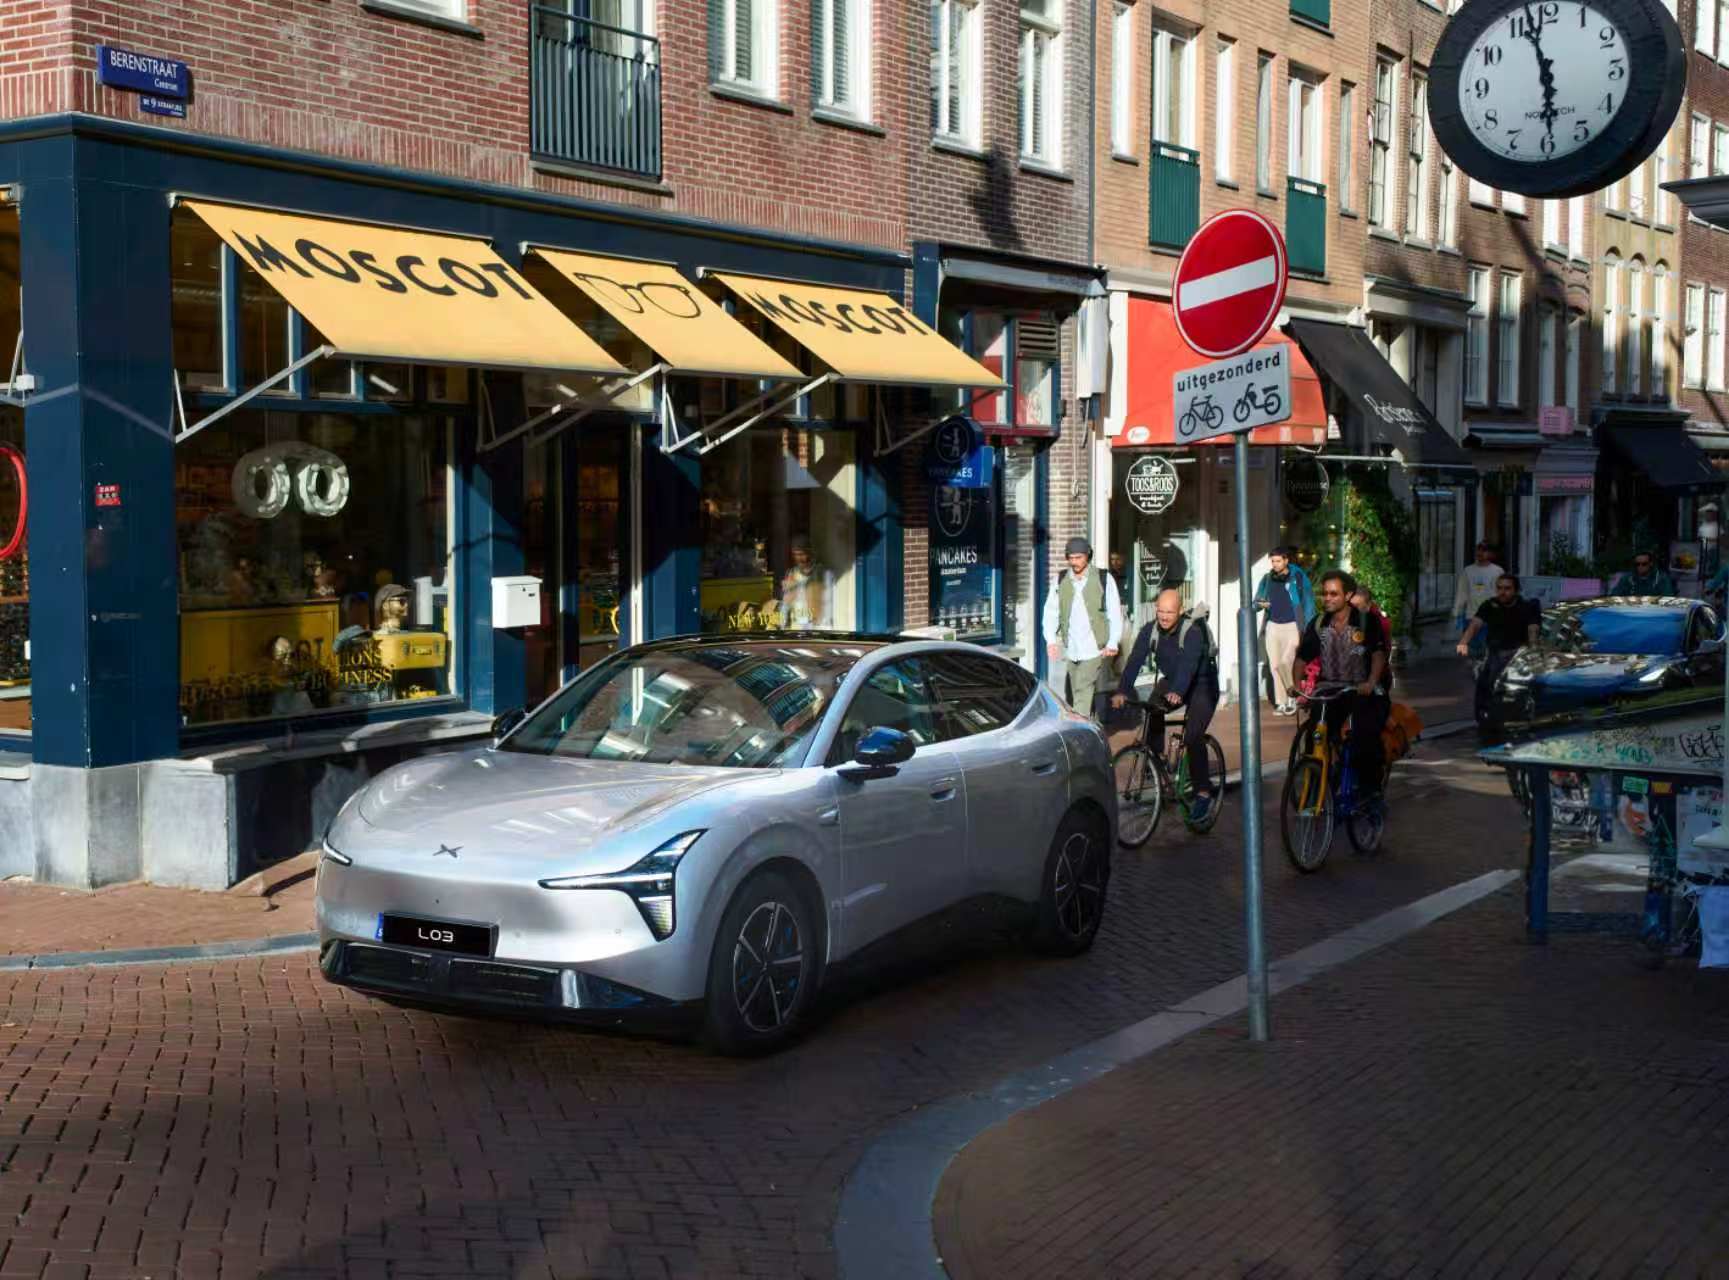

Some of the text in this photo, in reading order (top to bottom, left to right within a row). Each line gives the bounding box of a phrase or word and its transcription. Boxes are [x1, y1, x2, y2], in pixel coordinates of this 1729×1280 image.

[1510, 16, 1524, 39] 11
[1579, 6, 1588, 28] 1
[1600, 26, 1616, 50] 2
[110, 50, 178, 79] BERENSTRAAT
[1483, 45, 1503, 66] 10
[1608, 58, 1625, 81] 3
[1474, 77, 1490, 100] 9
[1525, 105, 1576, 121] NOTCH
[1597, 92, 1615, 115] 4
[1483, 108, 1498, 130] 8
[1573, 119, 1590, 142] 5
[1506, 128, 1522, 150] 7
[1540, 132, 1556, 155] 6
[231, 229, 535, 300] MOSCOT
[743, 291, 929, 336] MOSCOT
[1177, 351, 1281, 392] uitgezonderd
